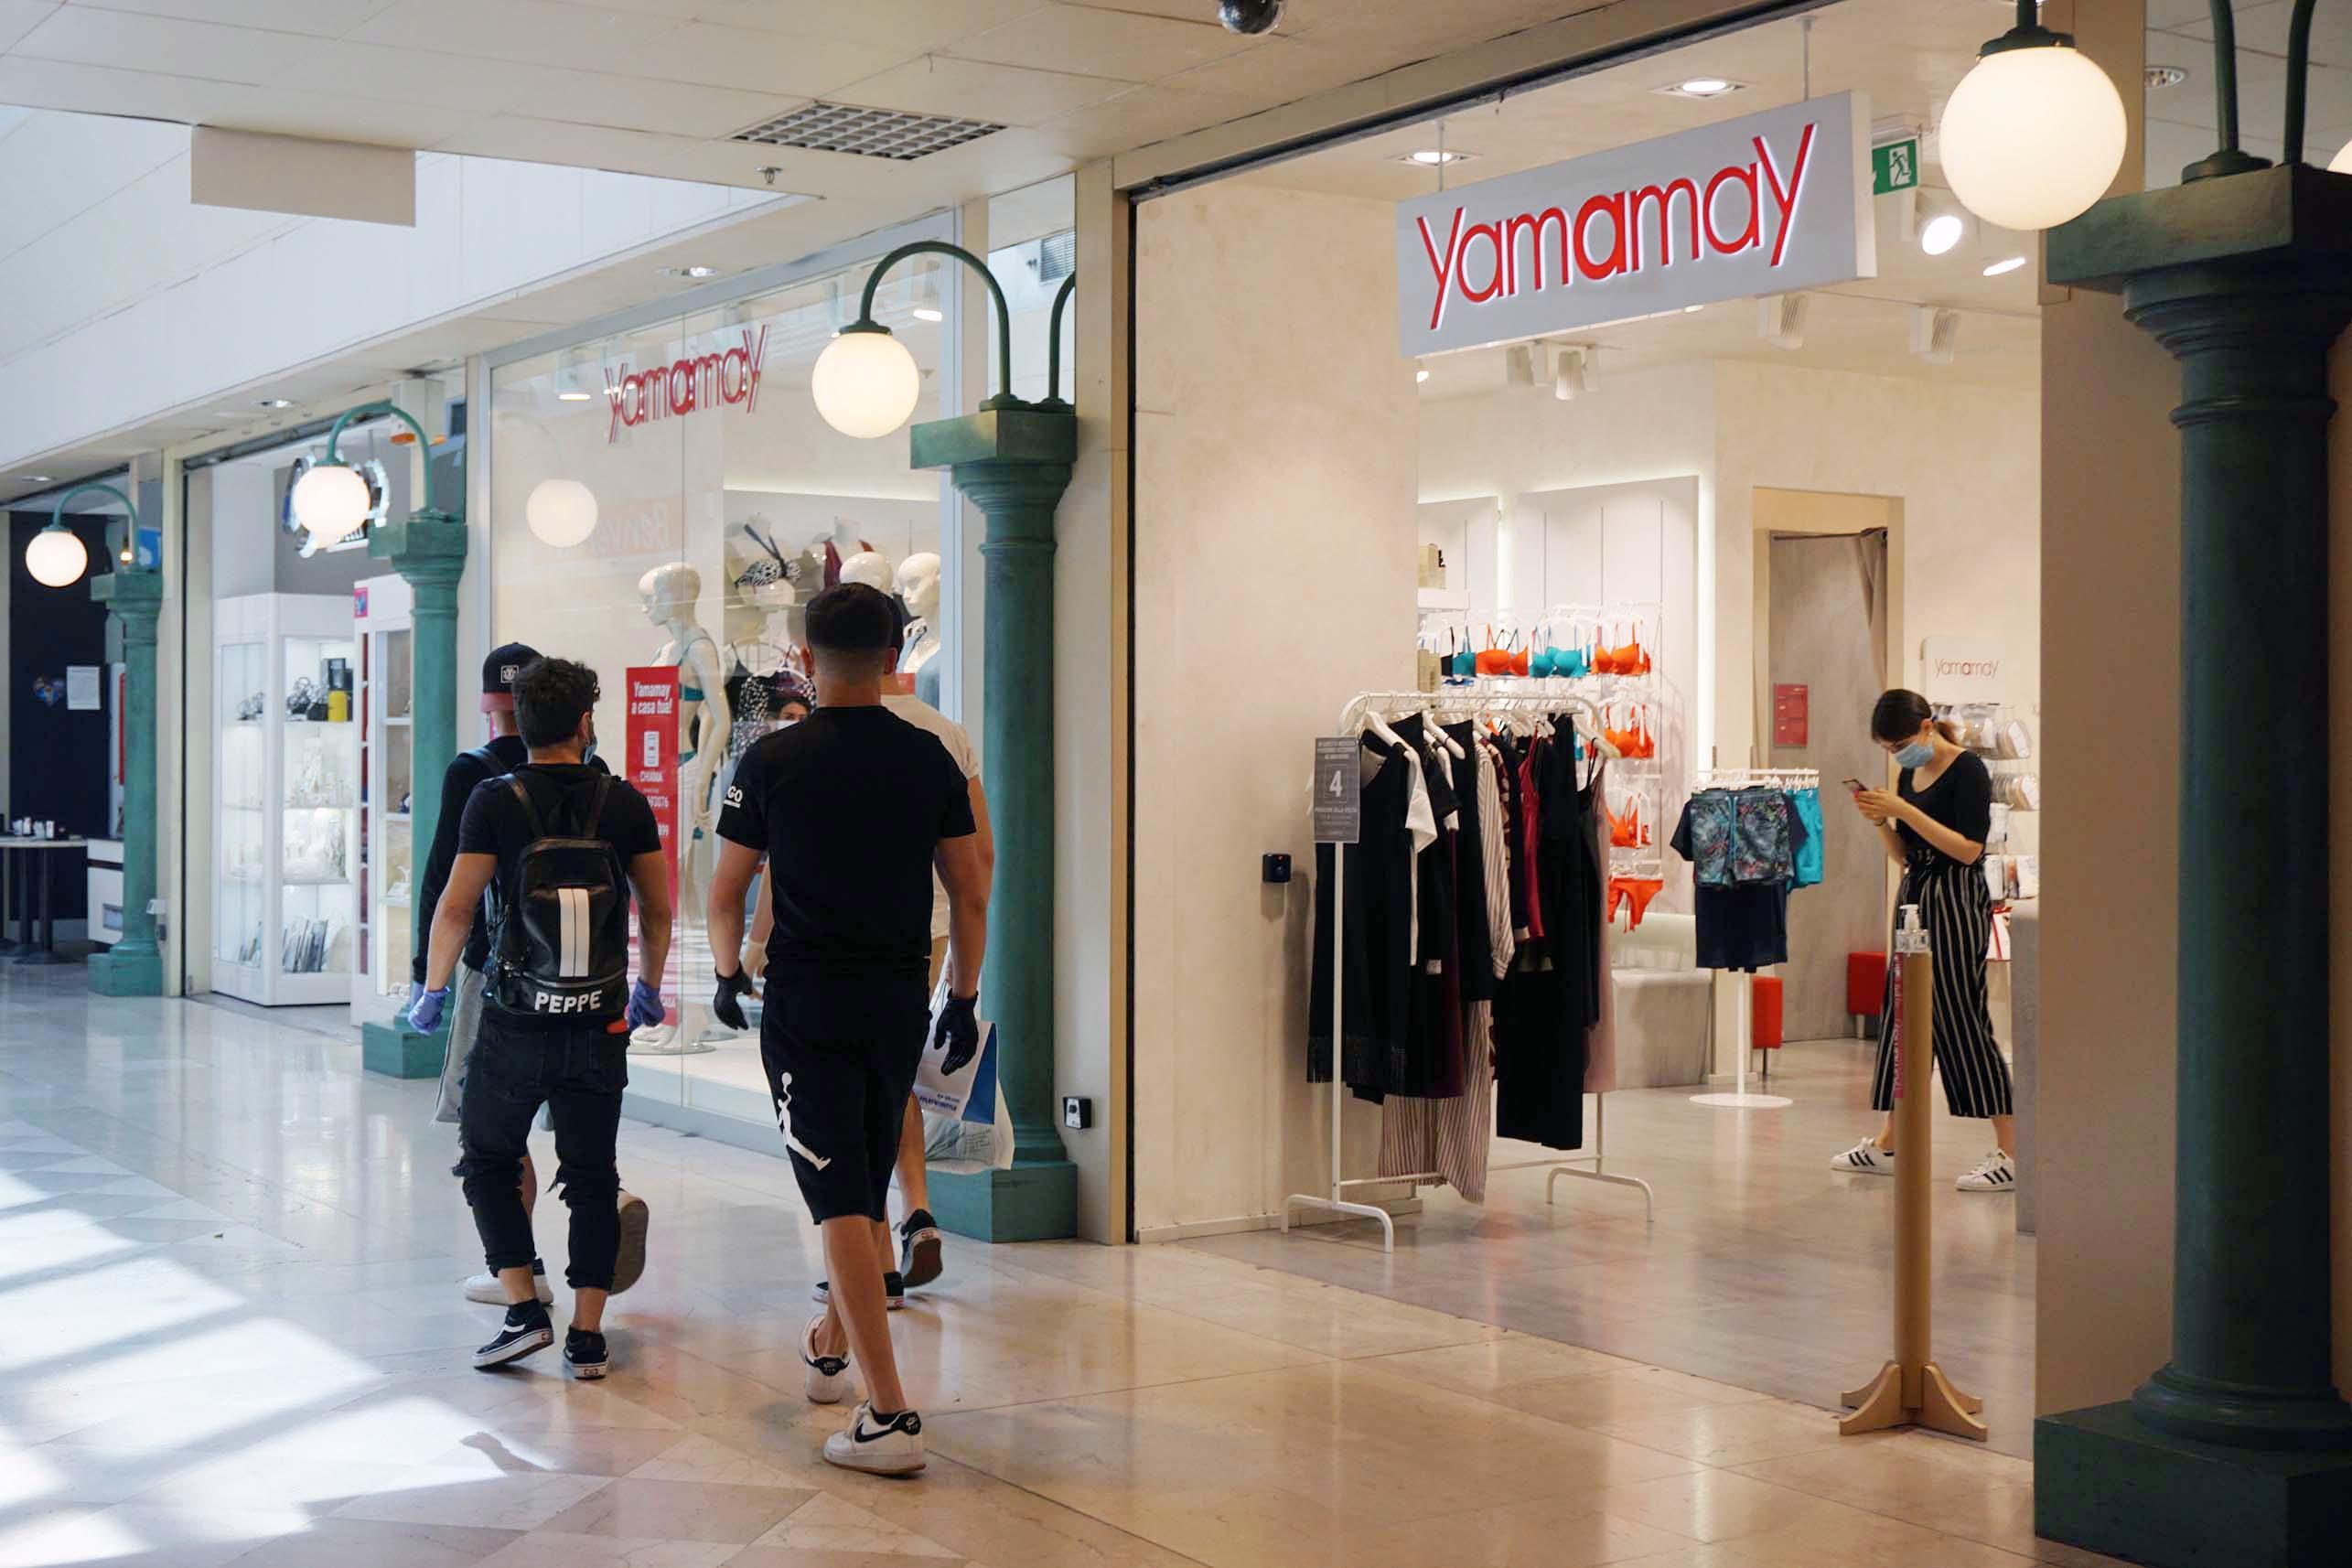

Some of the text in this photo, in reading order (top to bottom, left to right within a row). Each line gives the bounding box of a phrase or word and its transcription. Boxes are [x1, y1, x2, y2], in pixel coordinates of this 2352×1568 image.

[633, 681, 671, 702] Yamamay
[638, 701, 656, 714] casa
[1329, 769, 1343, 798] 4
[533, 989, 603, 1014] PEPPE
